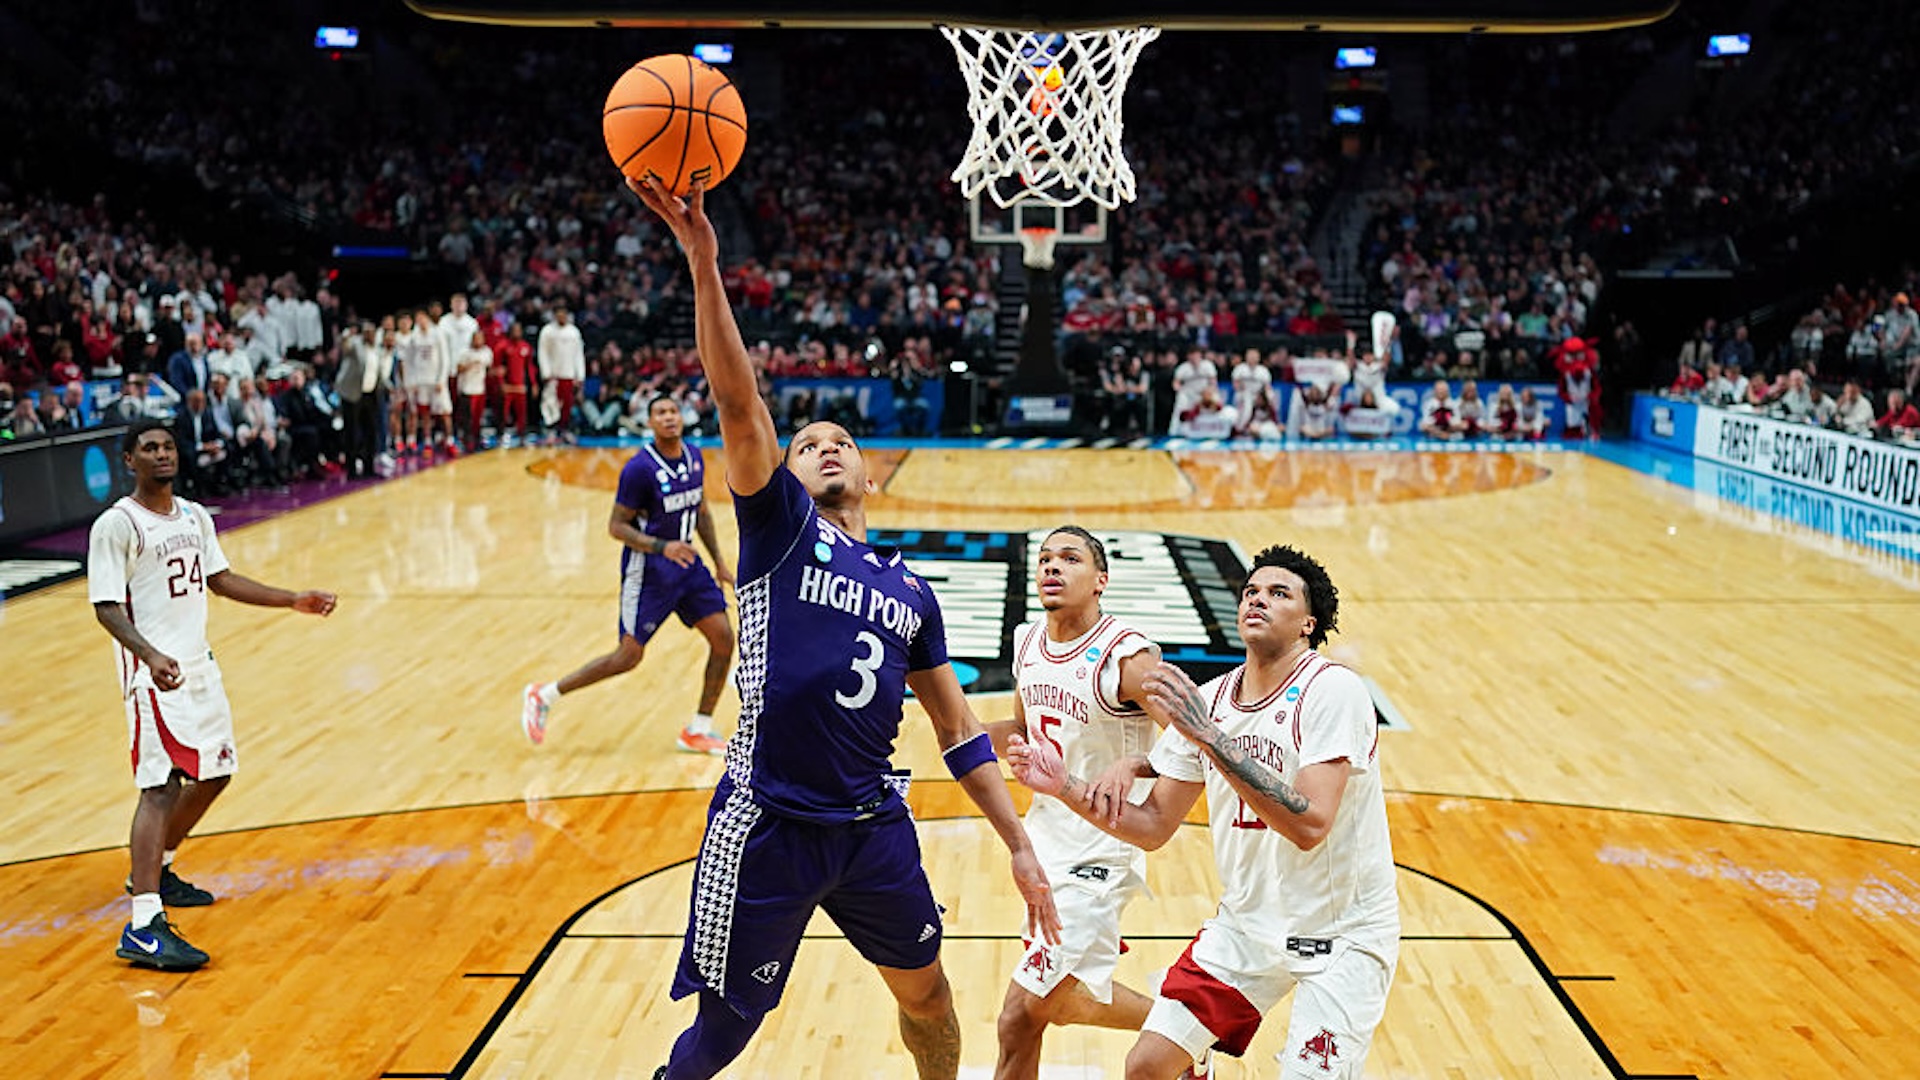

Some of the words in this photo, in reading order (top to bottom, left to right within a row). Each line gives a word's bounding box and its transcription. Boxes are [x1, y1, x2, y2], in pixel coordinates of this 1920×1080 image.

[1719, 418, 1759, 465] FIRST
[1771, 430, 1838, 485] SECOND
[1842, 445, 1920, 506] ROUND
[167, 552, 203, 599] 24
[798, 564, 866, 617] HIGH
[834, 630, 885, 710] 3
[1040, 714, 1064, 760] 5
